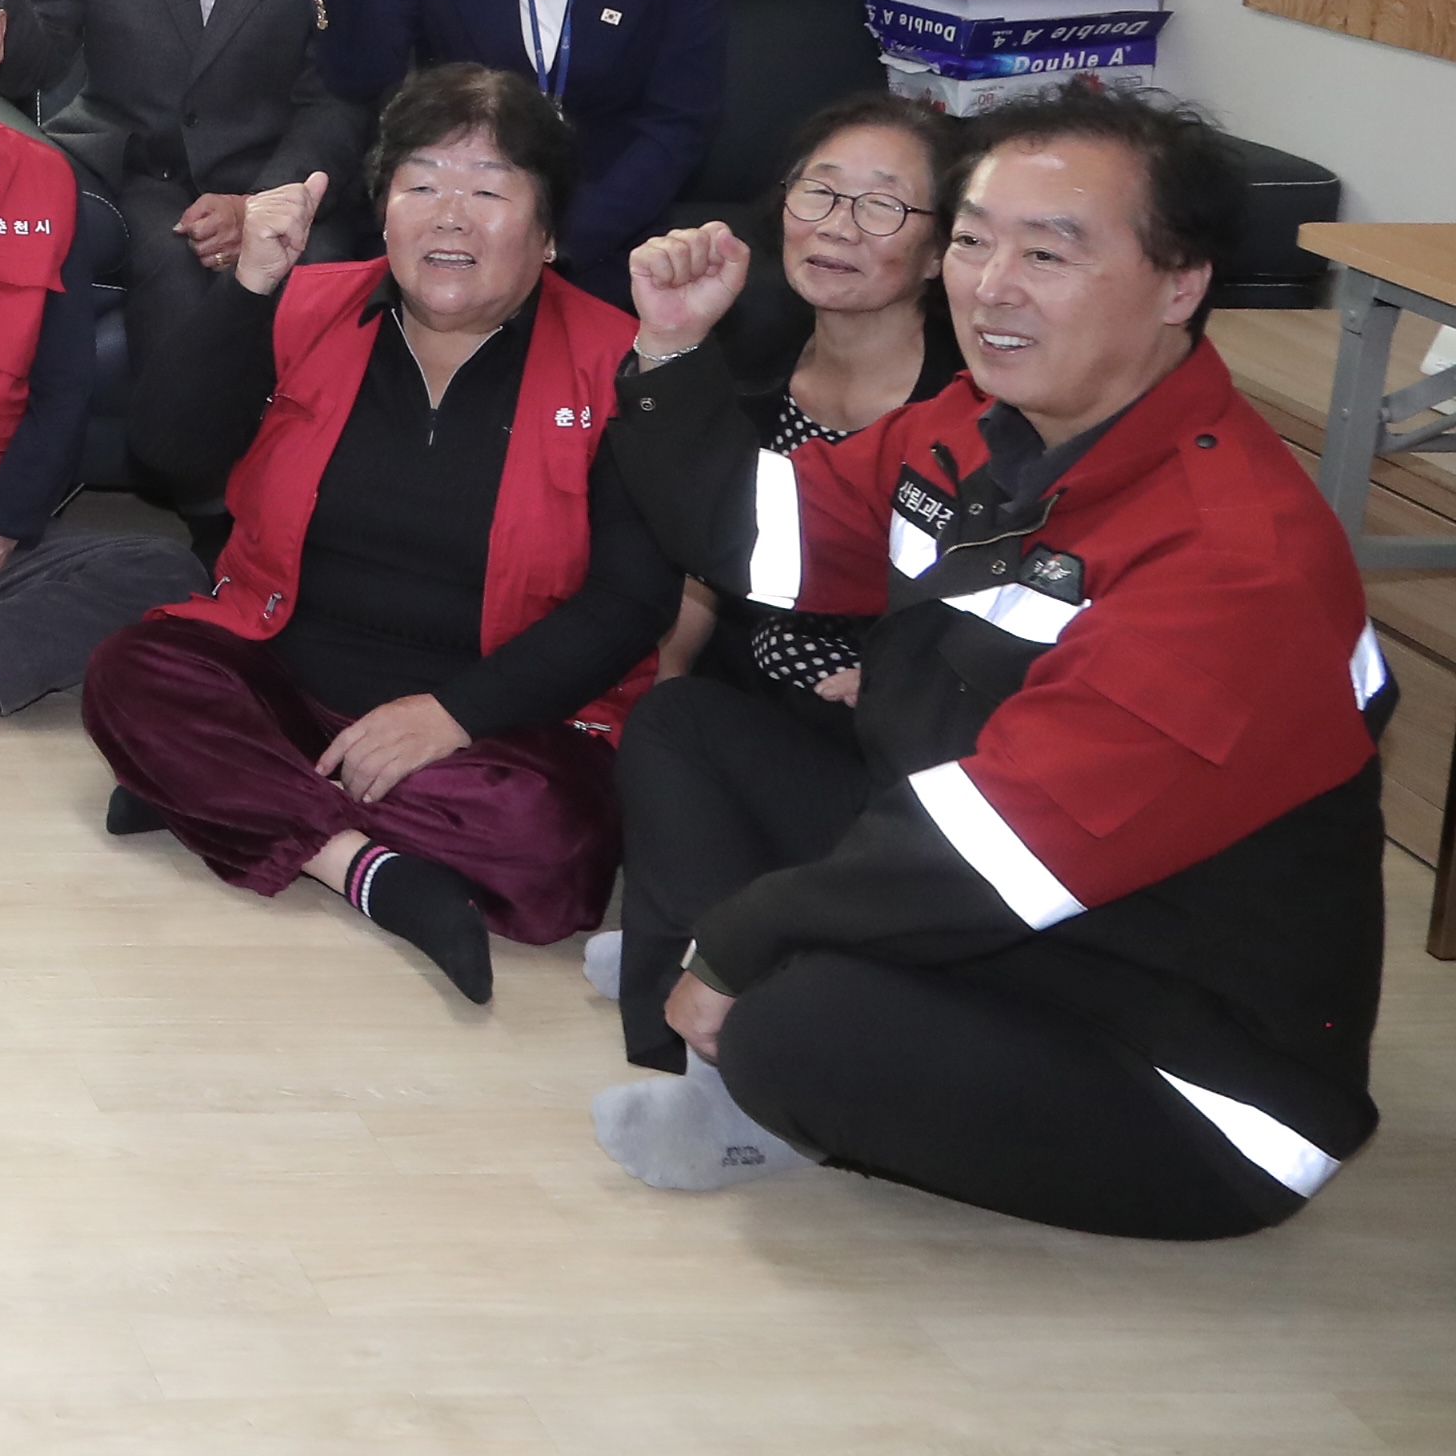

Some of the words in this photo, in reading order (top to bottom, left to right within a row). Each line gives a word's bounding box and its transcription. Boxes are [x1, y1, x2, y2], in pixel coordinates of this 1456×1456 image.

[899, 13, 956, 42] Double
[1021, 28, 1044, 46] A
[1051, 20, 1149, 41] Double
[1012, 51, 1099, 73] Double
[1108, 48, 1124, 65] A
